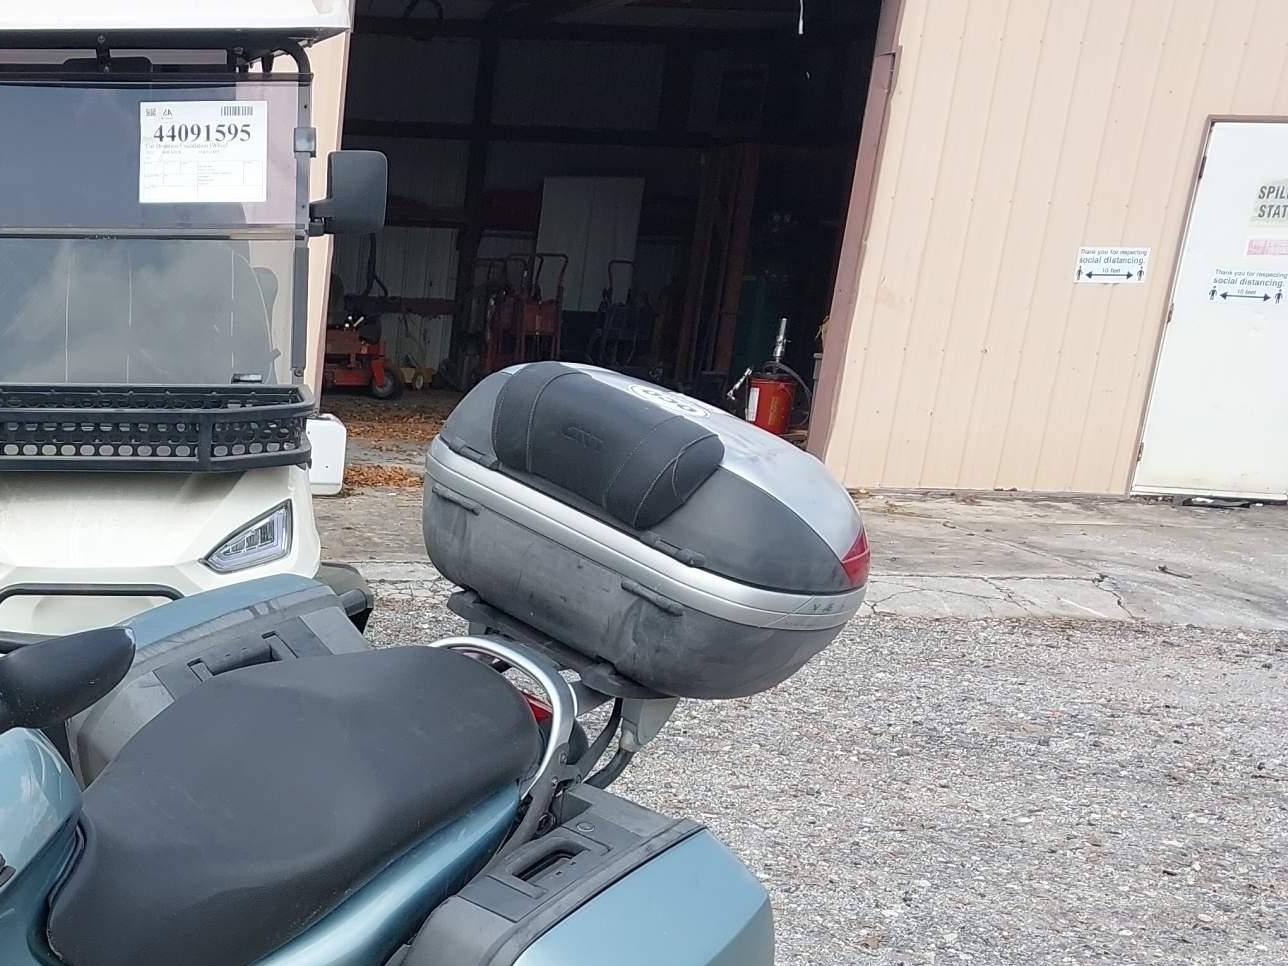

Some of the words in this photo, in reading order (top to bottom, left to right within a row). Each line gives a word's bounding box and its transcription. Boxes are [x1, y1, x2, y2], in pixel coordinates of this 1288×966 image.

[153, 124, 251, 142] 44091595
[1258, 185, 1288, 199] SPIL
[1079, 256, 1101, 264] social
